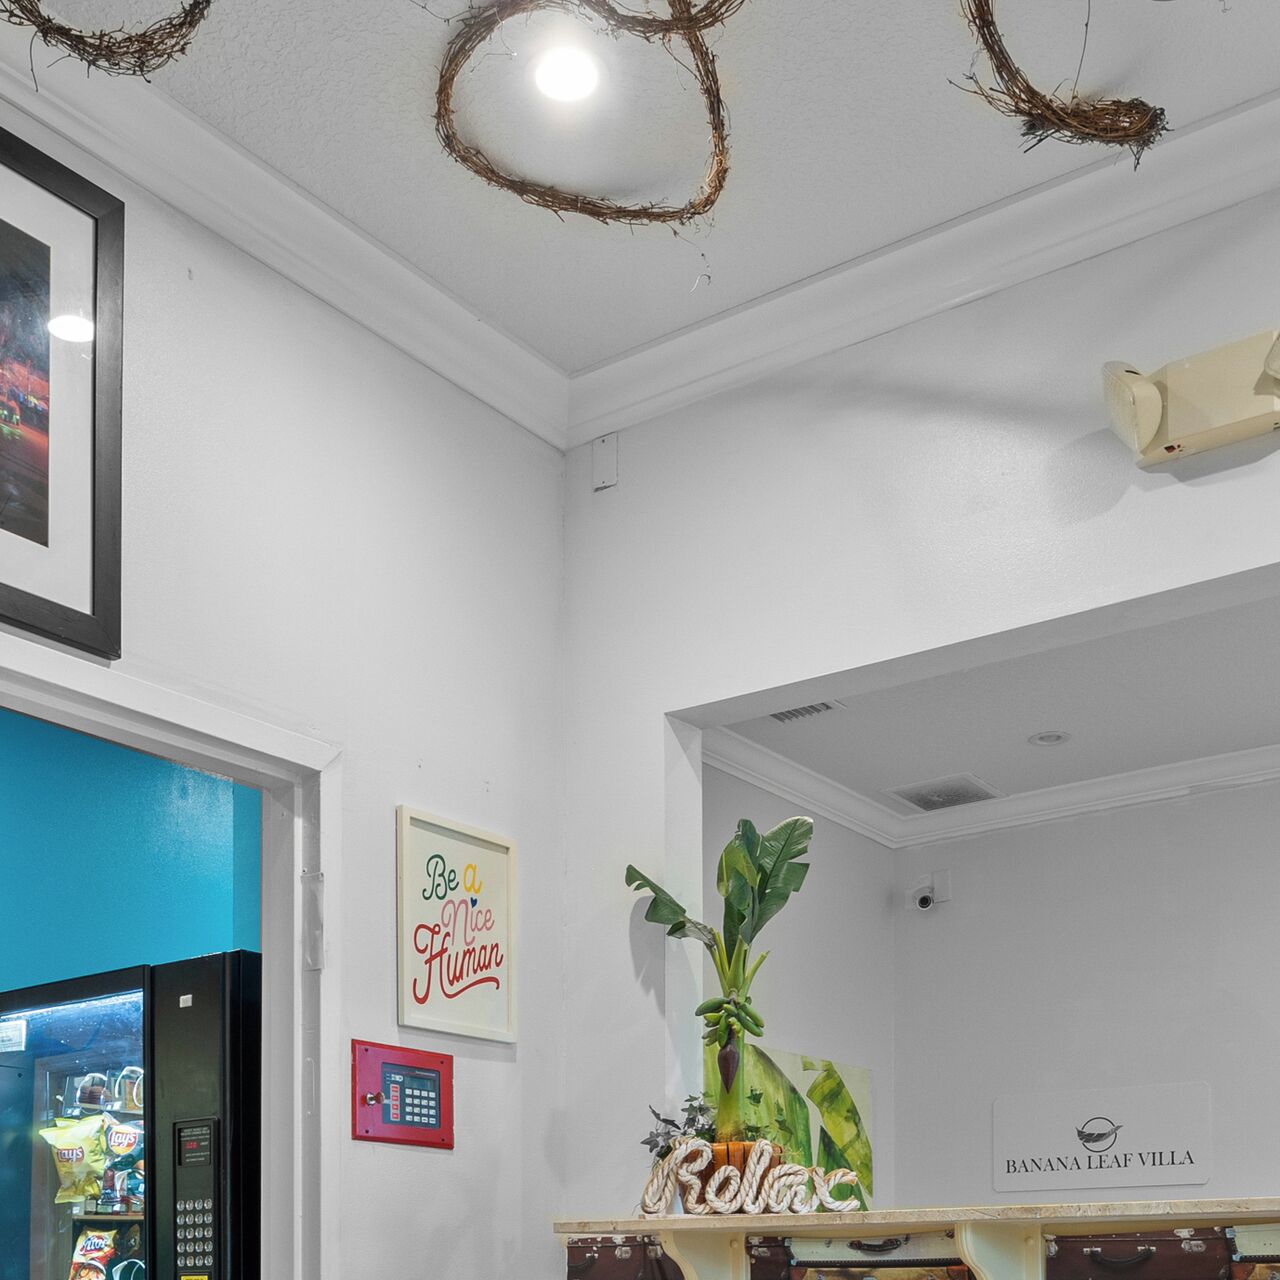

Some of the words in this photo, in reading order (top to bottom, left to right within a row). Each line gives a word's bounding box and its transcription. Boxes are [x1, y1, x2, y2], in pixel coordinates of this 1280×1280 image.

[422, 853, 460, 901] Be
[463, 863, 483, 895] a
[441, 896, 495, 947] Nice
[412, 922, 505, 1005] Human
[1006, 1156, 1081, 1174] BANANA
[1086, 1152, 1133, 1170] LEAF
[1138, 1150, 1195, 1167] VILLA
